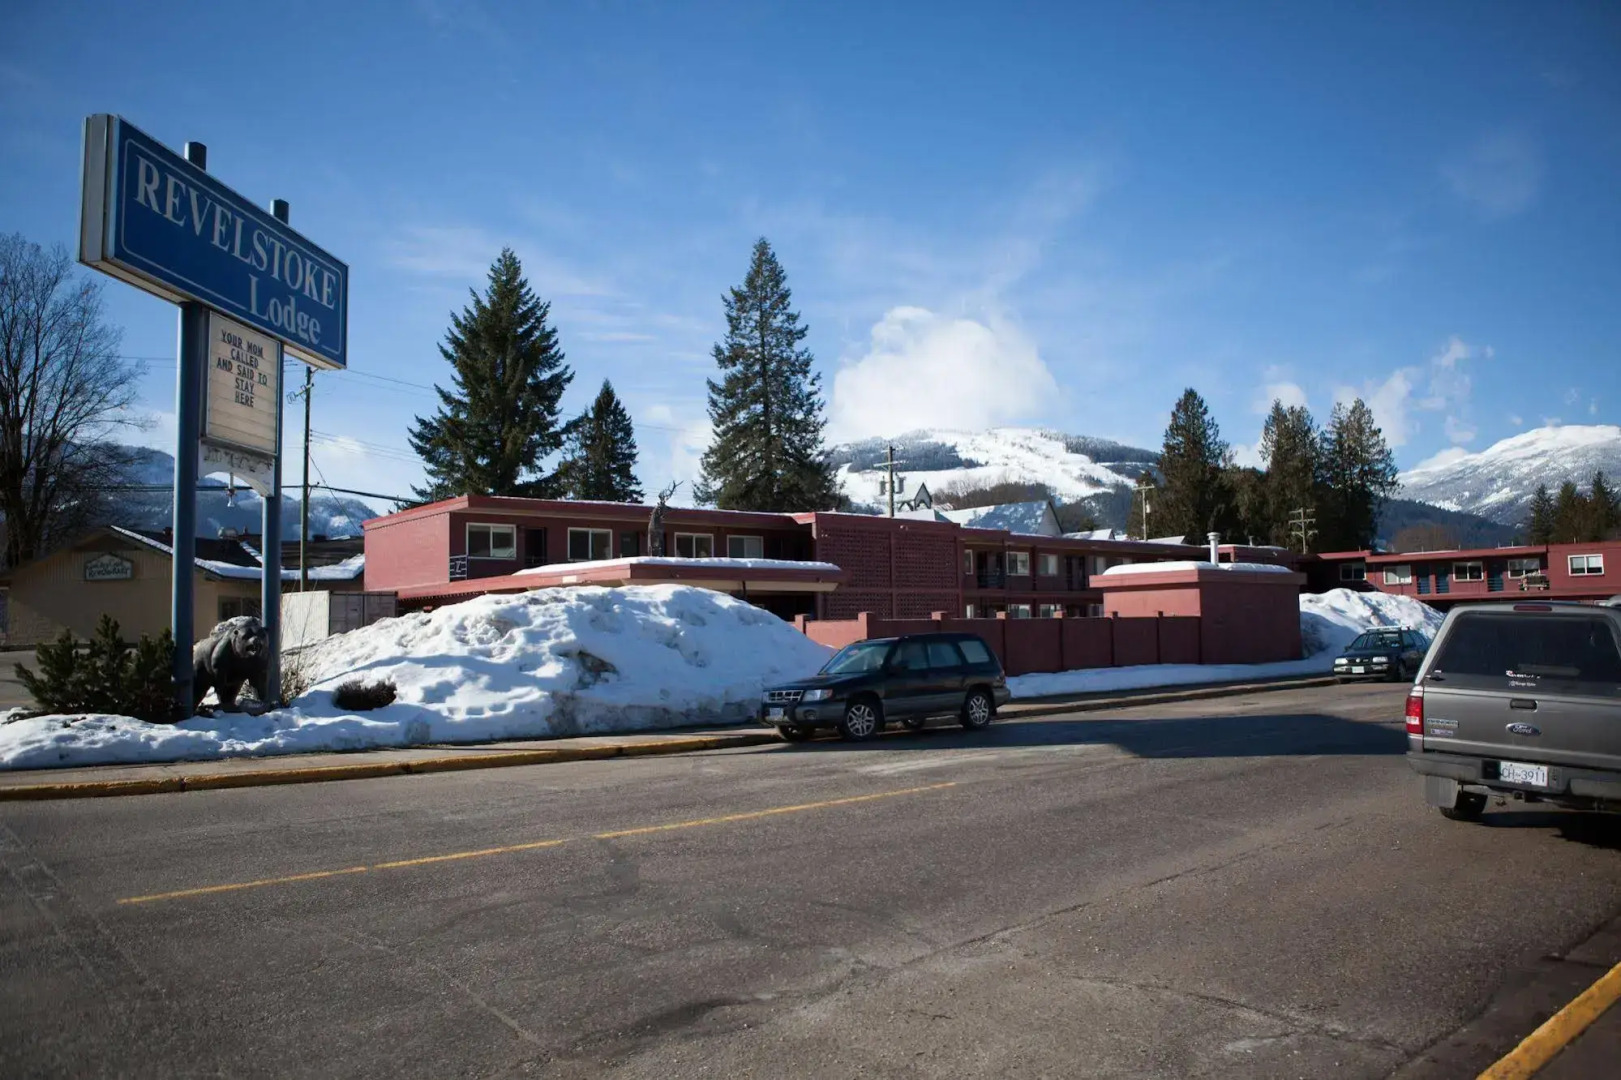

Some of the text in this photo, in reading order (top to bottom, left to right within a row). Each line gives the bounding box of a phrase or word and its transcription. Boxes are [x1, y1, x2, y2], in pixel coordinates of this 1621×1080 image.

[135, 155, 336, 310] REVELSTOKE
[249, 273, 321, 344] Lodge
[222, 329, 264, 357] YOUR MOM
[231, 348, 259, 369] CALLED
[217, 357, 268, 386] AND SAID TO
[235, 378, 254, 395] STAY
[235, 391, 254, 407] HERE
[1512, 724, 1532, 734] Ford
